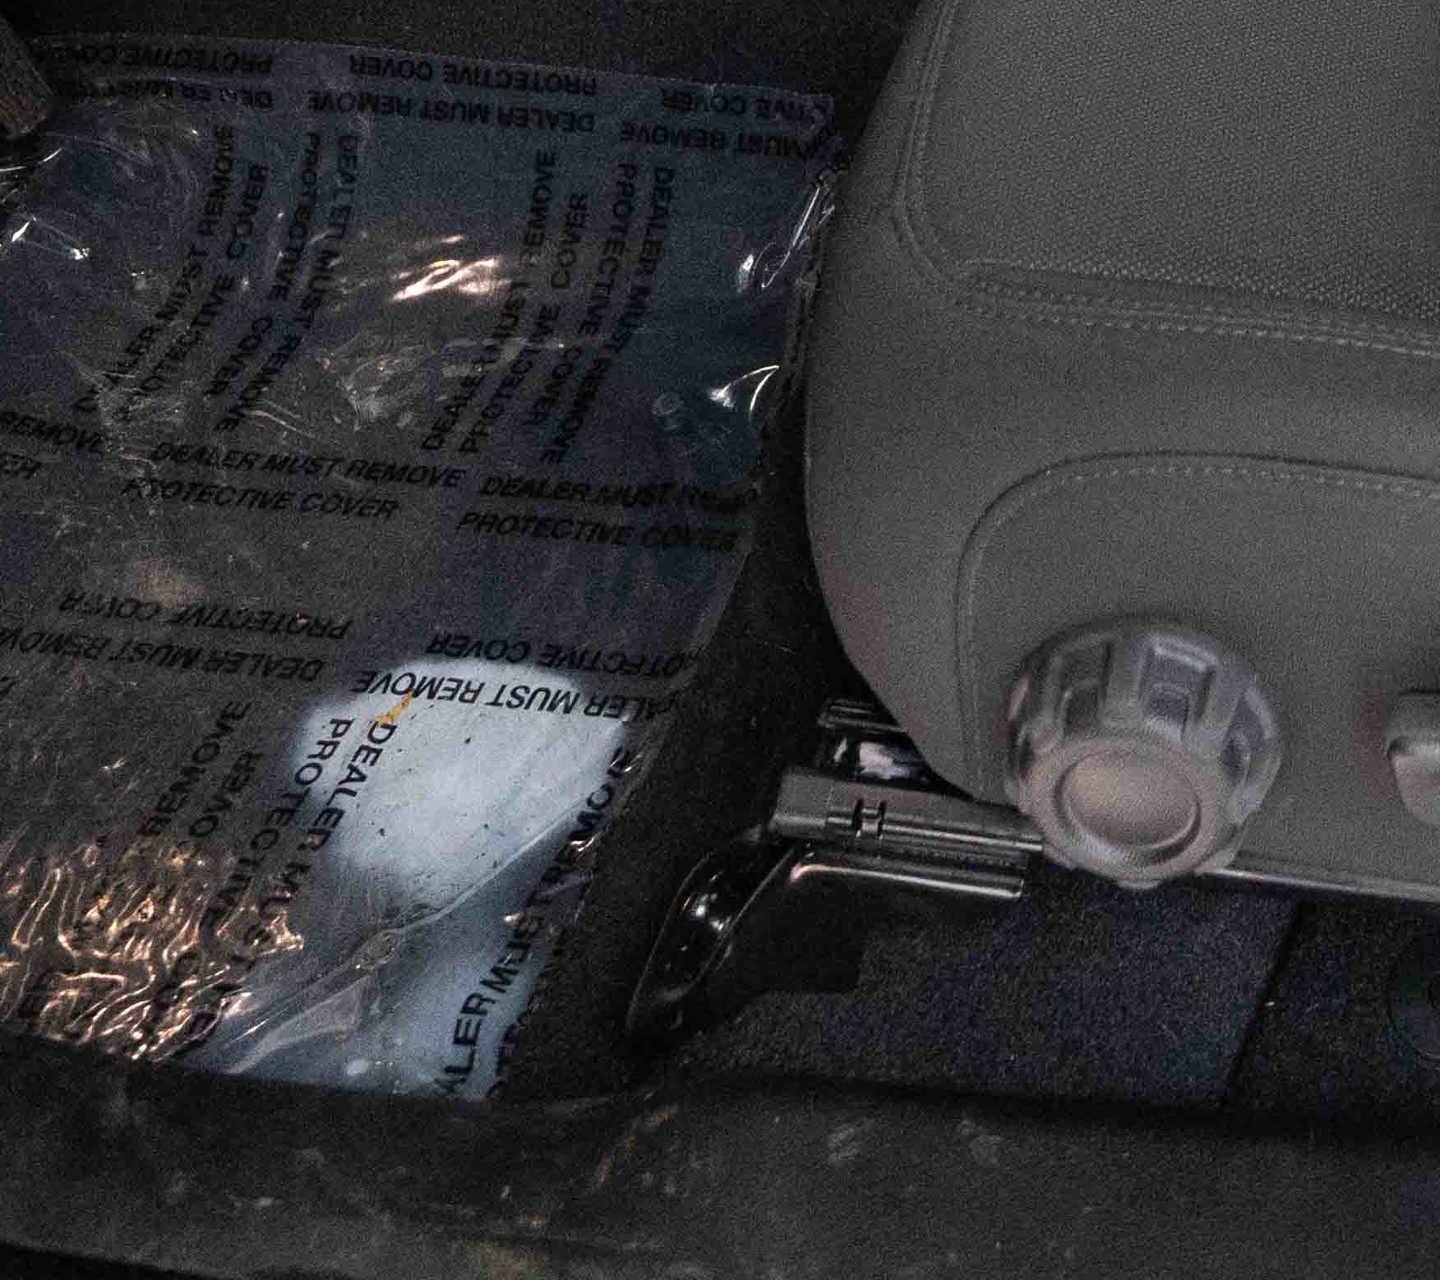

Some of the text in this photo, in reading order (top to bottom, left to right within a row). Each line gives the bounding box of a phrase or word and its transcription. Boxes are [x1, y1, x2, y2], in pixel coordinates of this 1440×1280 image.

[349, 54, 597, 96] PROTECTIVE COVER
[308, 90, 596, 133] DEALER MUST REMOVE
[661, 89, 747, 115] COVER
[621, 121, 727, 150] REMOVE
[156, 243, 208, 321] MUST
[197, 121, 234, 237] REMOVE
[226, 163, 269, 261] COVER
[637, 164, 676, 276] DEALER
[206, 132, 322, 397] PROTECTIVE COVER
[550, 191, 590, 290] COVER
[577, 161, 639, 337] PROTECTIVE
[294, 248, 340, 329] MUST
[603, 284, 651, 355] MUST
[150, 441, 468, 489] DEALER MUST REMOVE
[478, 475, 593, 502] DEALER
[122, 476, 400, 520] PROTECTIVE COVER
[456, 511, 637, 547] PROTECTIVE
[59, 589, 353, 640] PROTECTIVE COVER
[108, 638, 203, 670] MUST
[203, 650, 326, 683] DEALER
[425, 633, 533, 665] COVER
[356, 669, 485, 705] REMOVE
[485, 682, 582, 716] MUST
[137, 699, 252, 838] REMOVE
[302, 719, 397, 854] DEALER
[187, 750, 266, 840] OVER
